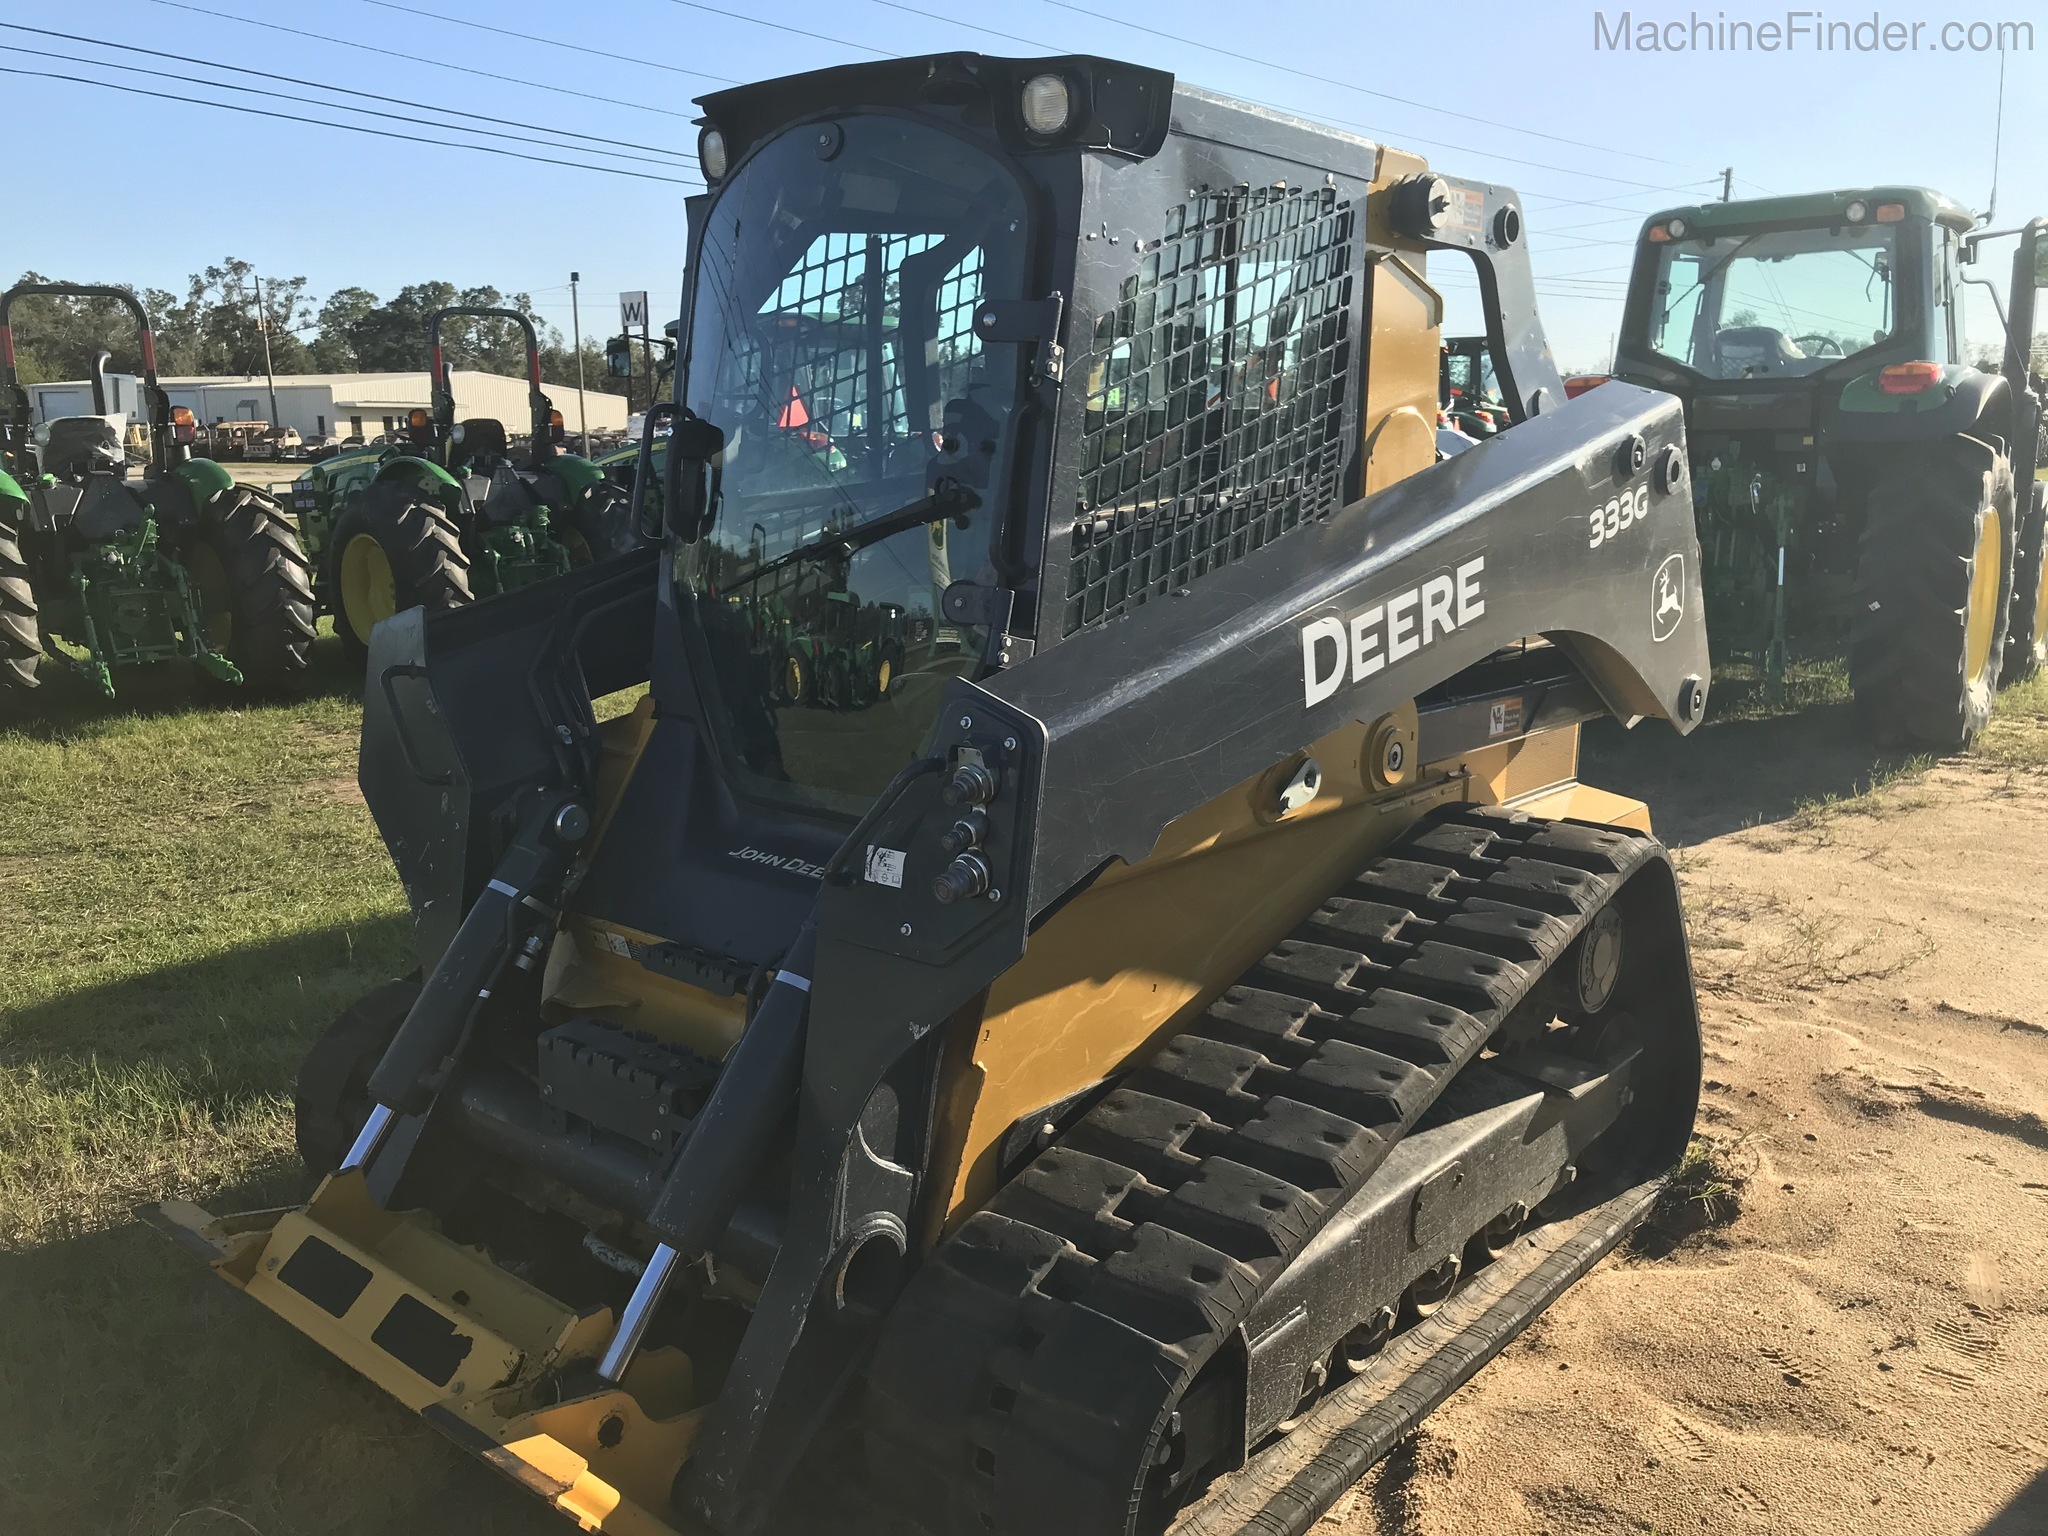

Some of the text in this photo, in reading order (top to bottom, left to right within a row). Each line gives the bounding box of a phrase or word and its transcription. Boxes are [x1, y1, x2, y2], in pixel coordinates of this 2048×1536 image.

[622, 302, 641, 322] W
[1589, 484, 1648, 549] 333G
[1302, 555, 1485, 709] DEERE
[728, 846, 825, 880] JOHN DEE
